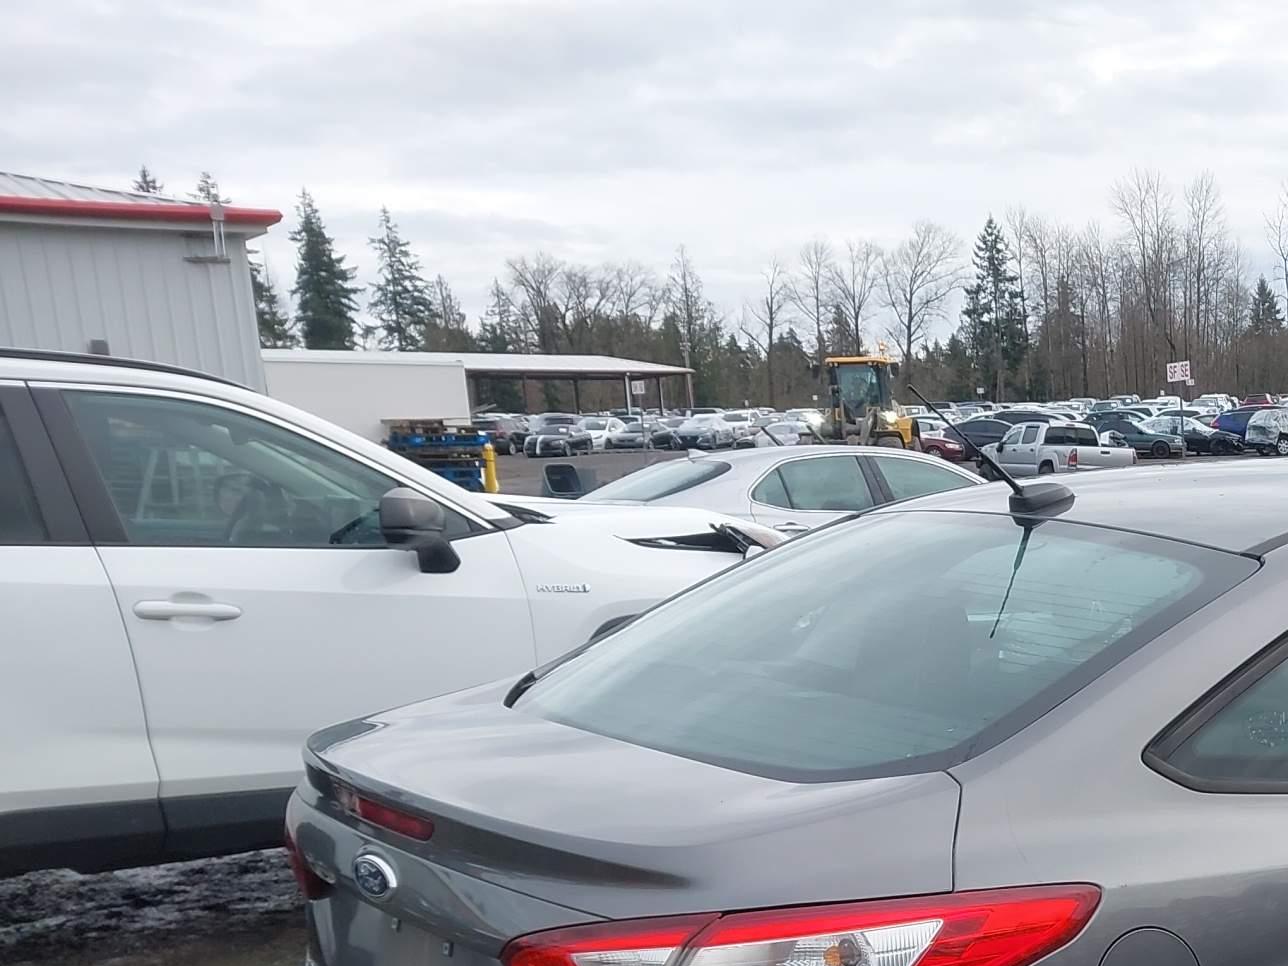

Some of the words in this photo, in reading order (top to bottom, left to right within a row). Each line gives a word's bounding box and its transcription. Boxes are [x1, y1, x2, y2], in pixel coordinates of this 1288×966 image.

[1168, 364, 1177, 380] SF
[1180, 362, 1189, 378] SE
[535, 583, 584, 593] HYBRID
